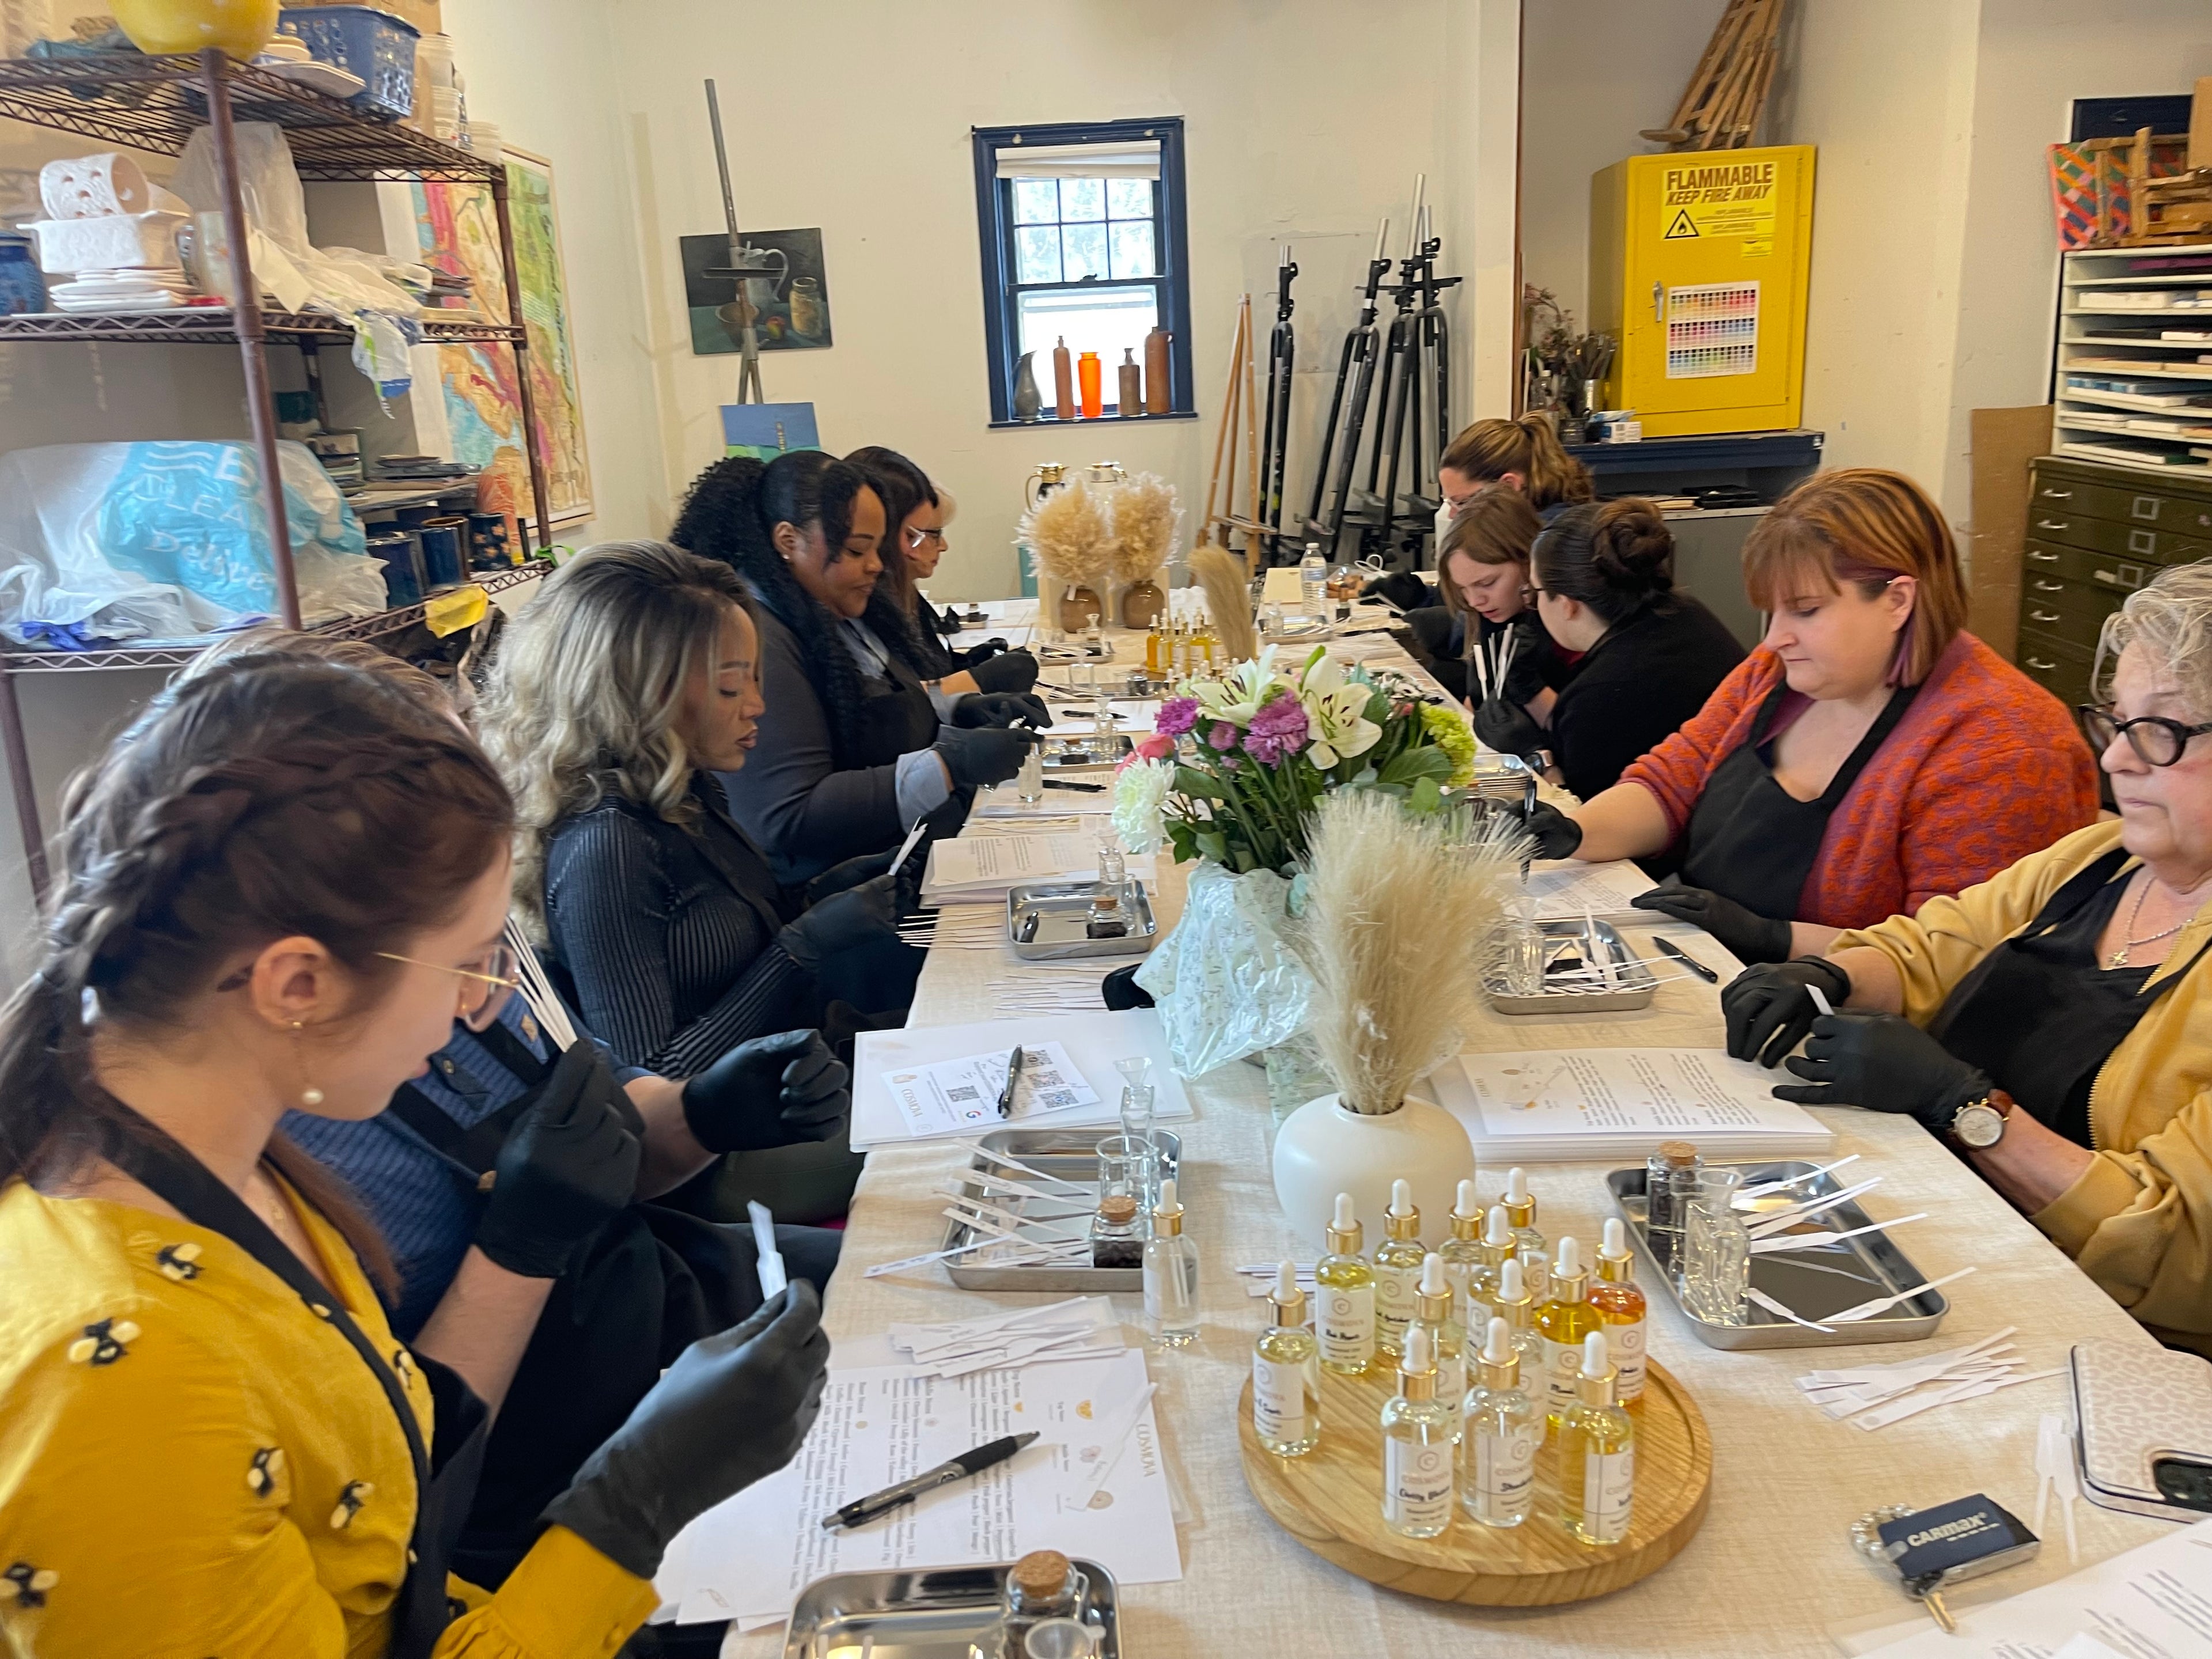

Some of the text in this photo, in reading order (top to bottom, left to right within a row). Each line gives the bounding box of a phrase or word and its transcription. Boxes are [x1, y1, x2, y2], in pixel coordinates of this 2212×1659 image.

[1668, 164, 1772, 191] FLAMMABLE
[1665, 184, 1772, 206] KEEP FIRE AWAY
